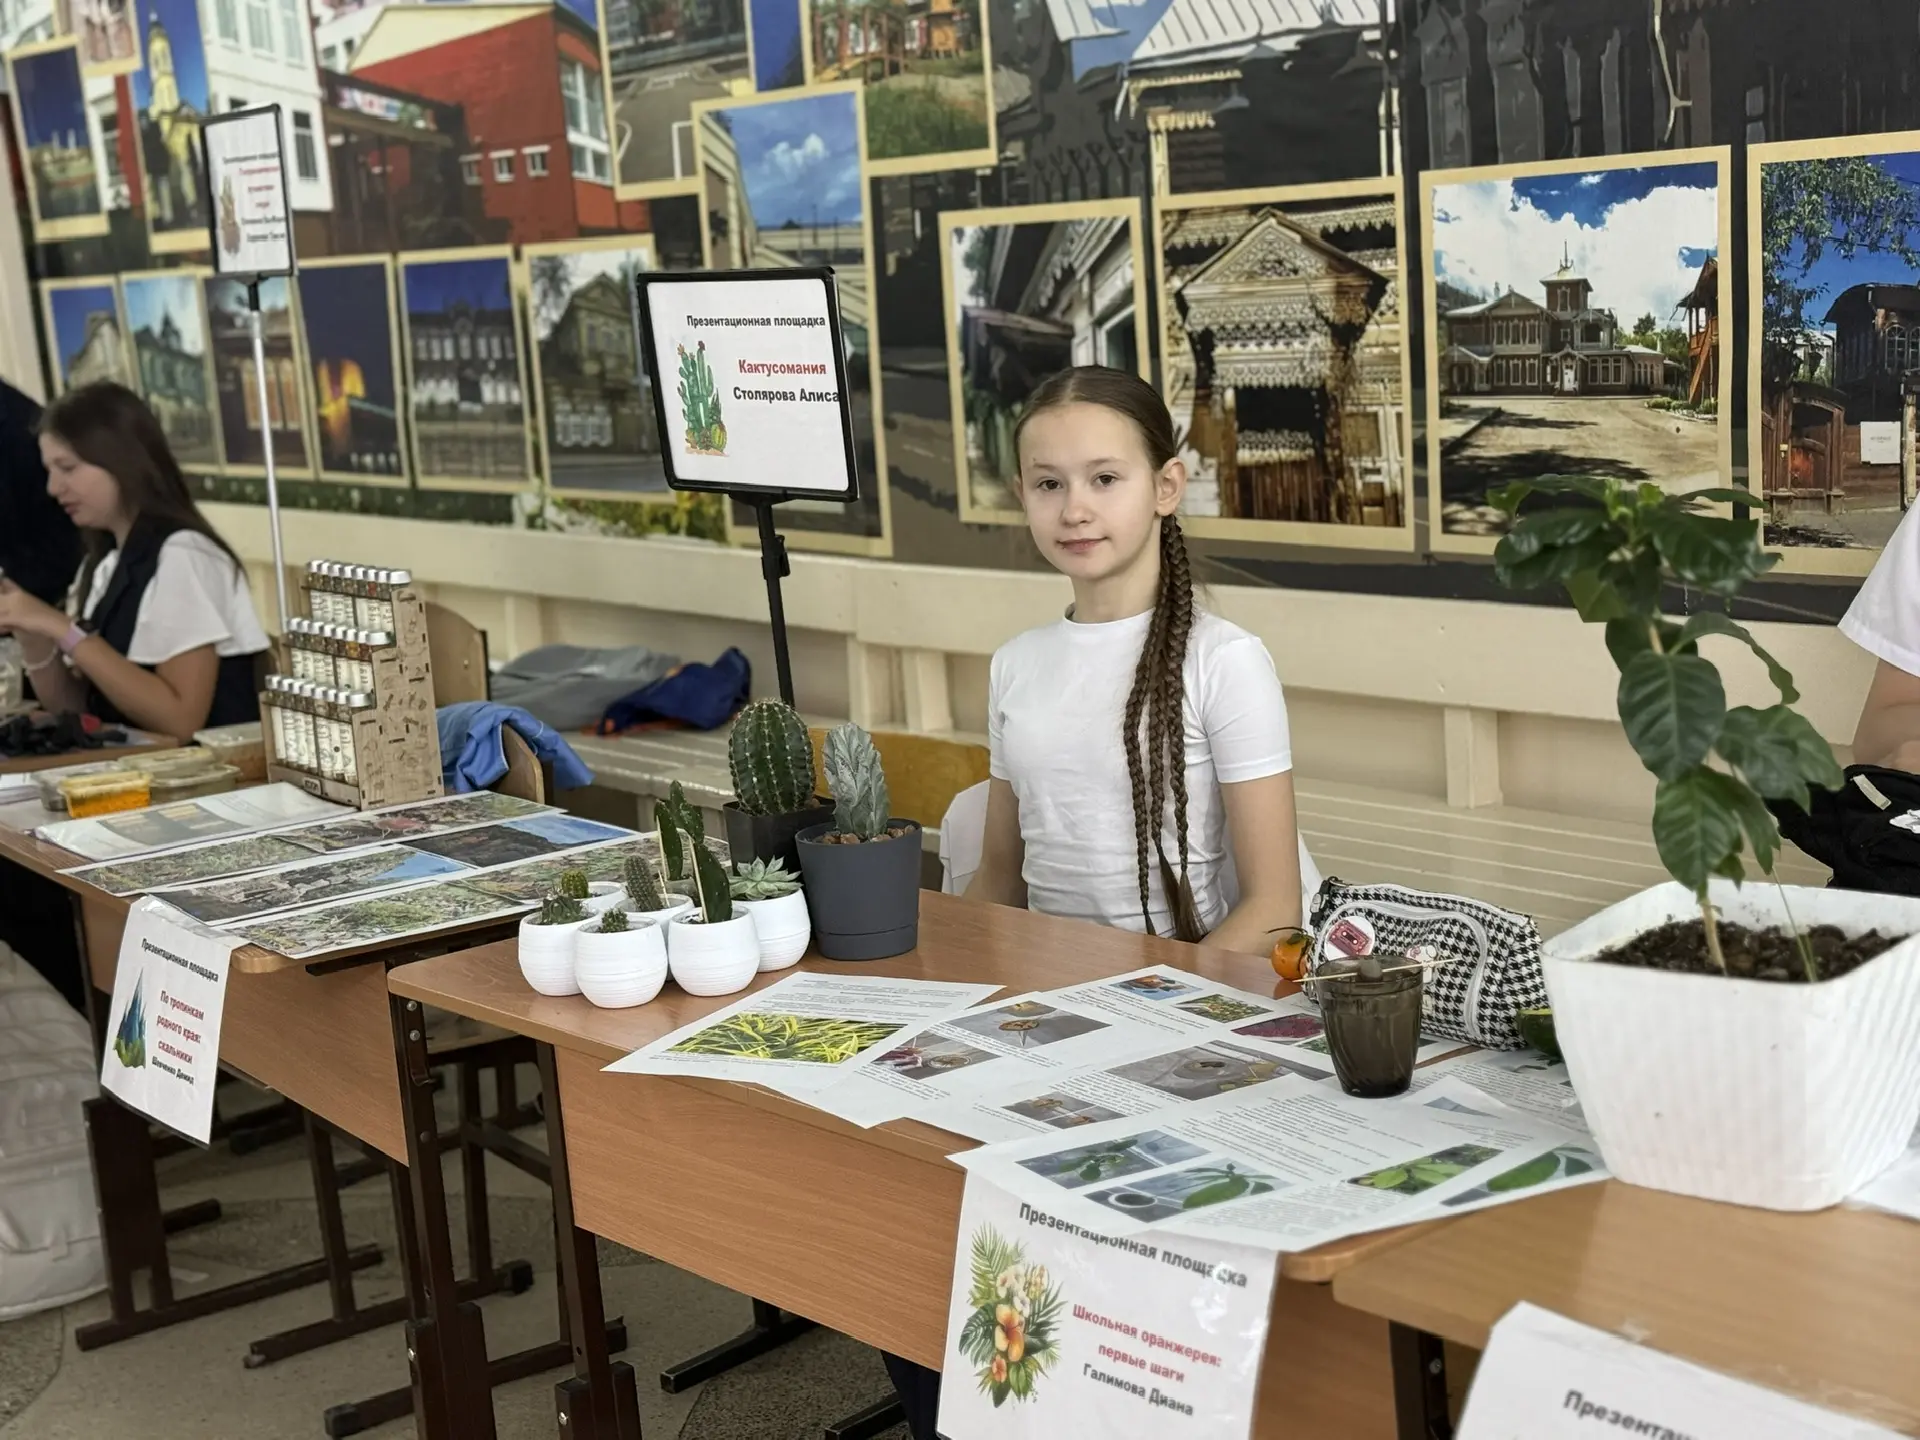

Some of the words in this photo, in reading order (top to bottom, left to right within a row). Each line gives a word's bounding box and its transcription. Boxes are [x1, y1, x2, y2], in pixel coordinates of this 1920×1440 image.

[686, 315, 771, 329] Презентационная
[774, 315, 826, 328] площадка
[738, 359, 827, 377] Кактусомания
[733, 386, 796, 404] Столярова
[799, 387, 840, 403] Алиса
[141, 938, 188, 969] Презентационная
[188, 960, 219, 983] площадка
[160, 990, 169, 1004] По
[169, 995, 204, 1021] тропинкам
[156, 1015, 183, 1036] родного
[183, 1026, 201, 1044] края:
[158, 1039, 193, 1065] скальники
[1072, 1303, 1138, 1340] Школьная
[1140, 1329, 1223, 1368] оранжерея:
[1097, 1343, 1147, 1374] первые
[1149, 1362, 1185, 1383] шаги
[1082, 1362, 1147, 1399] Галимова
[1148, 1387, 1194, 1417] Диана
